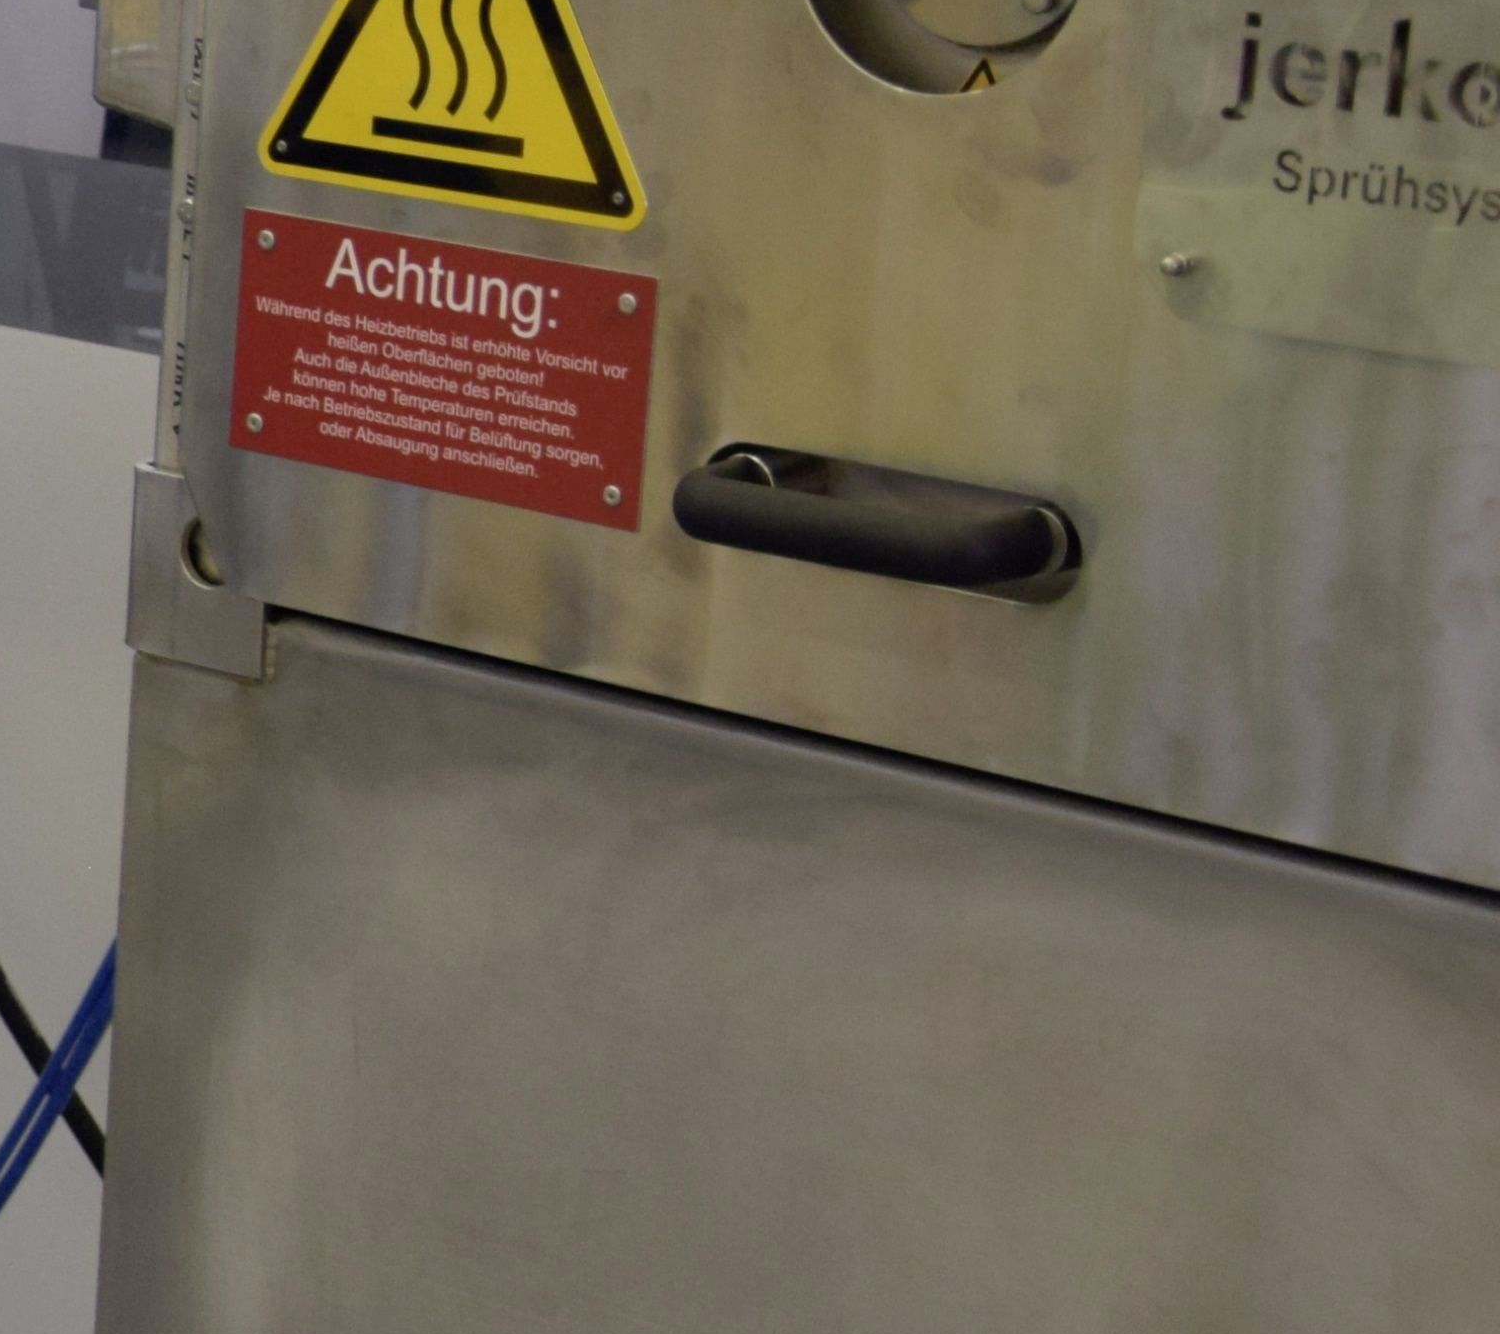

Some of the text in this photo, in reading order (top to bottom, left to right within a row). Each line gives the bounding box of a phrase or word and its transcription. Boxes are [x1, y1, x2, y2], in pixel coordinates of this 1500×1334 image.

[1221, 12, 1500, 129] jerko
[1273, 149, 1500, 226] Sprühsys
[325, 237, 560, 340] Achtung:
[256, 296, 628, 380] Während des Heizbetriebs ist erhöhte Vorsicht vor
[327, 331, 543, 388] heißen Oberflächen geboten!
[293, 371, 574, 440] können hohe Temperaturen erreichen.
[294, 348, 578, 417] Auch die Außenbleche des Prüfstands
[263, 386, 604, 470] Je nach Betriebszustand für Belüftung sorgen,
[320, 421, 539, 478] oder Absaugung anschließen.
